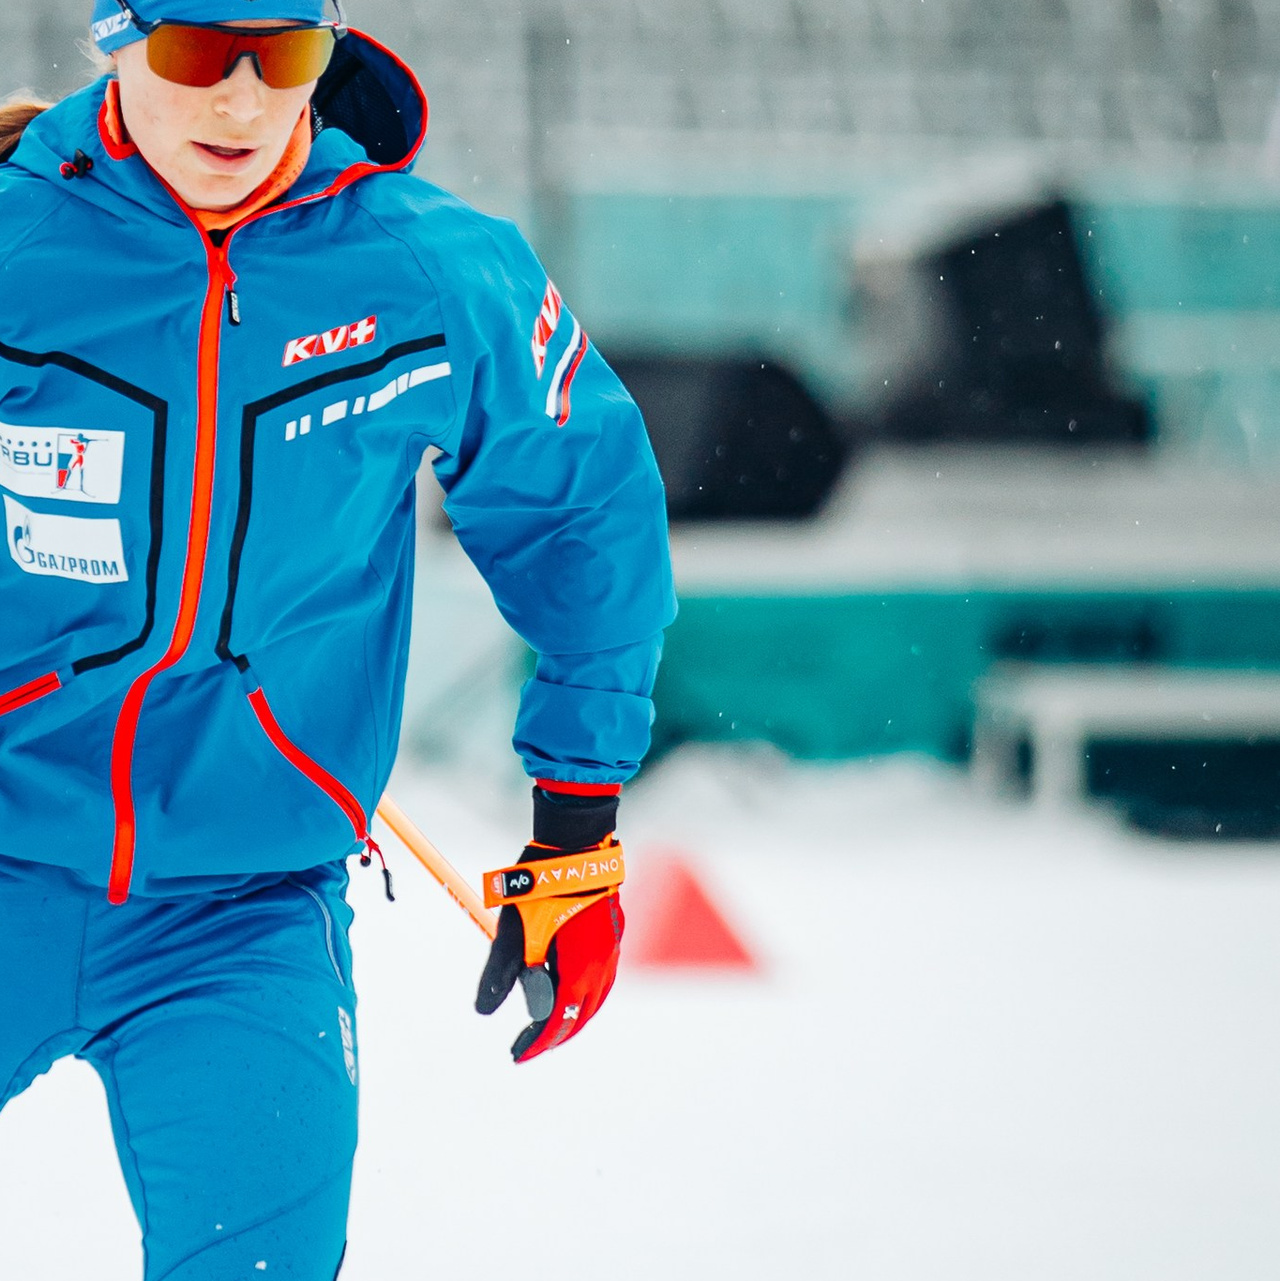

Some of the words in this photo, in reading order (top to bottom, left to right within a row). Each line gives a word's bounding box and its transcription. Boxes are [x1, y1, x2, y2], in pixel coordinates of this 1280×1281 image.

[282, 314, 377, 367] KV+
[531, 278, 561, 380] KV
[0, 444, 52, 467] RBU
[37, 551, 119, 577] GAZPROM
[536, 856, 620, 885] ONE/WAY
